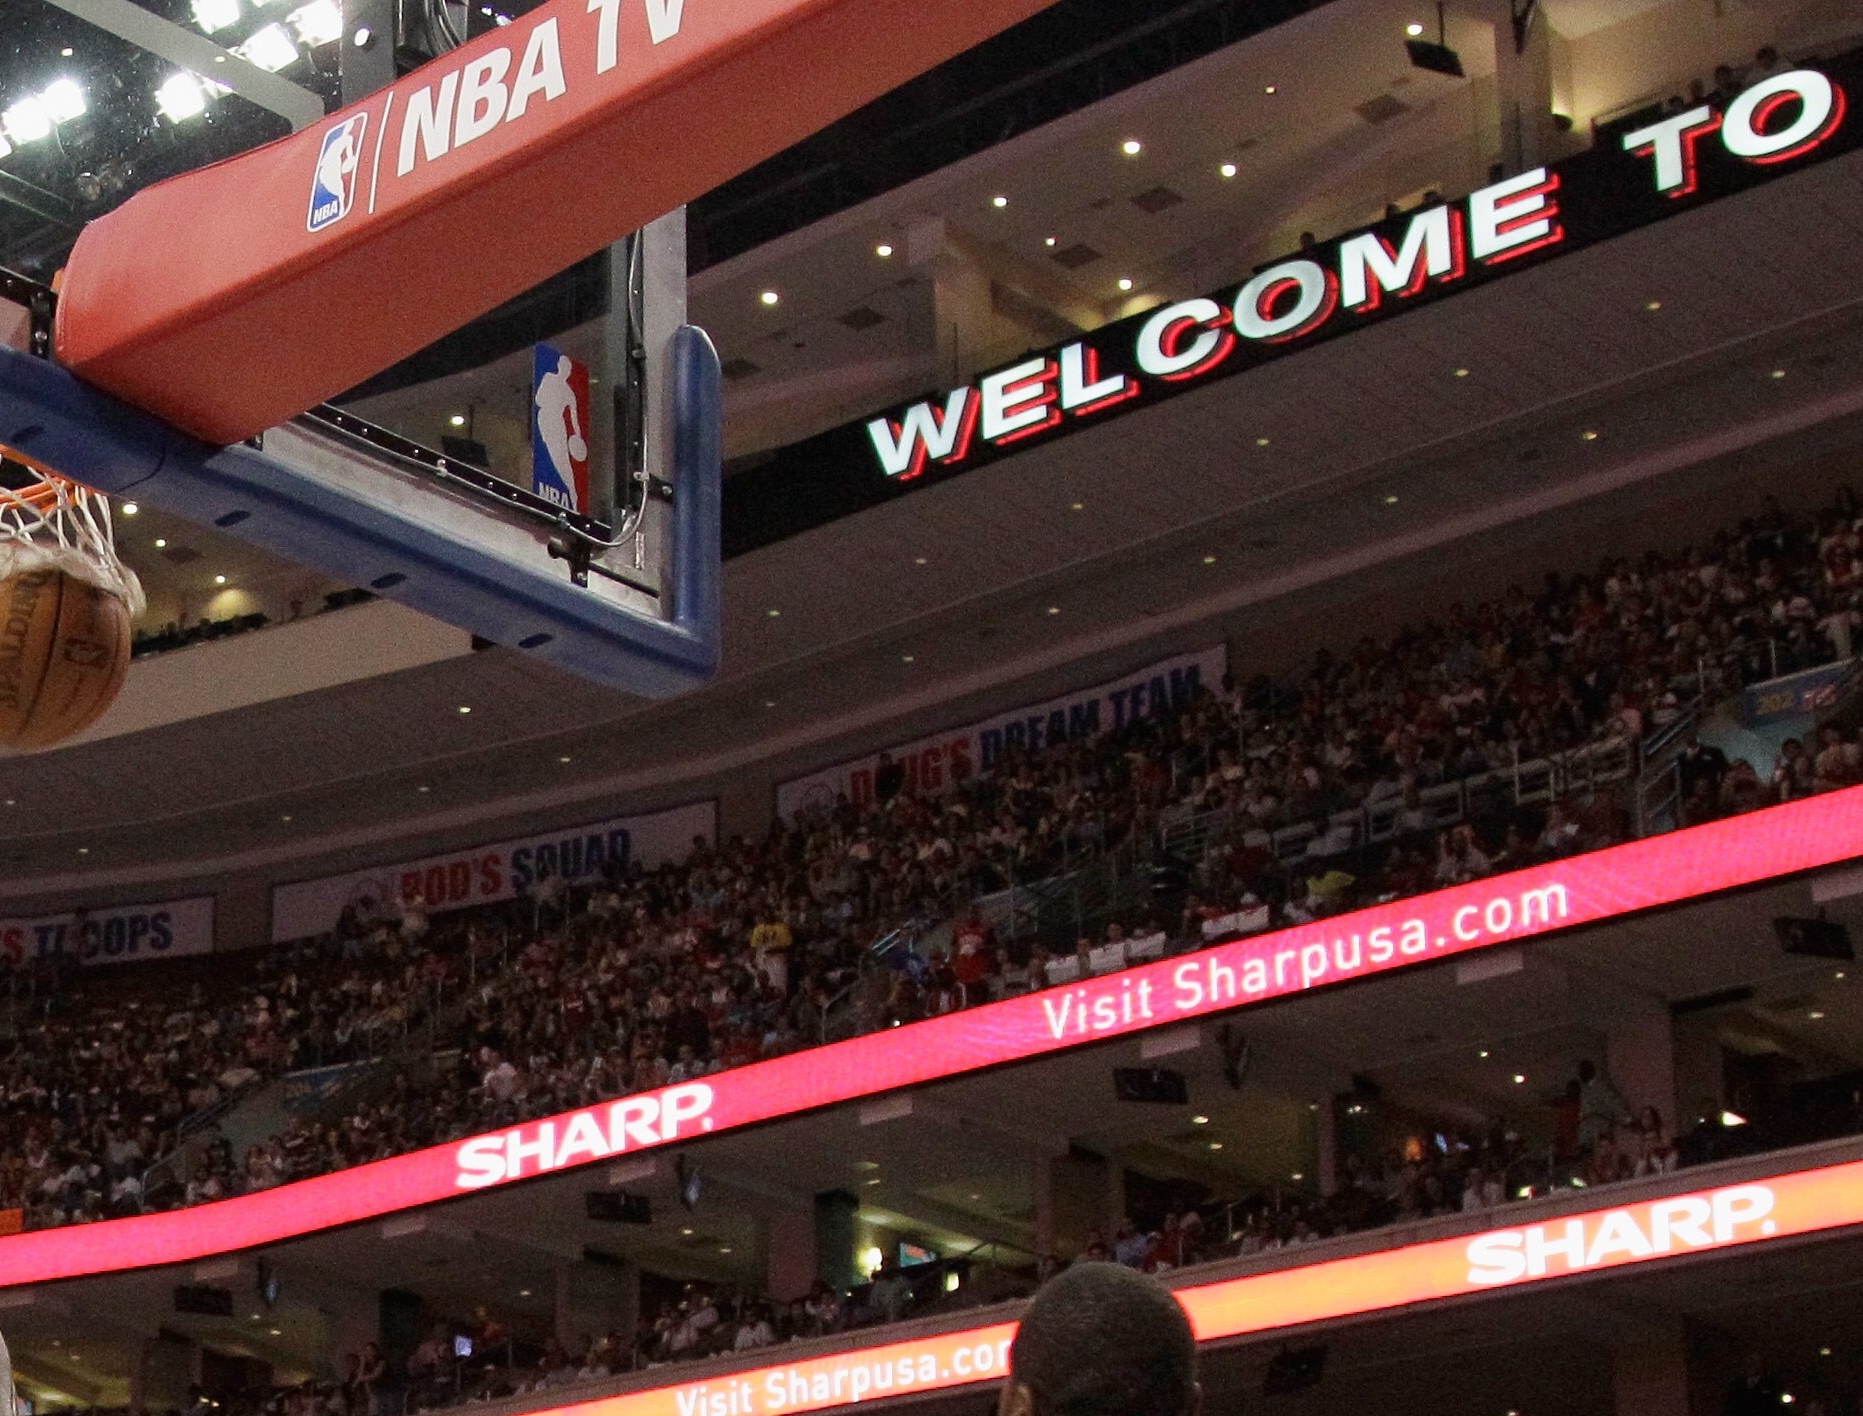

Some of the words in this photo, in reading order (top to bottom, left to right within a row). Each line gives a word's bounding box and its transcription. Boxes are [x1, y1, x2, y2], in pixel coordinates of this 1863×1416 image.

[398, 16, 566, 178] NBA
[312, 201, 339, 225] NBA
[866, 167, 1562, 480] WELCOME
[1624, 69, 1846, 198] TO
[1042, 976, 1154, 1040] Visit
[1174, 882, 1568, 1012] Sharpusa.com
